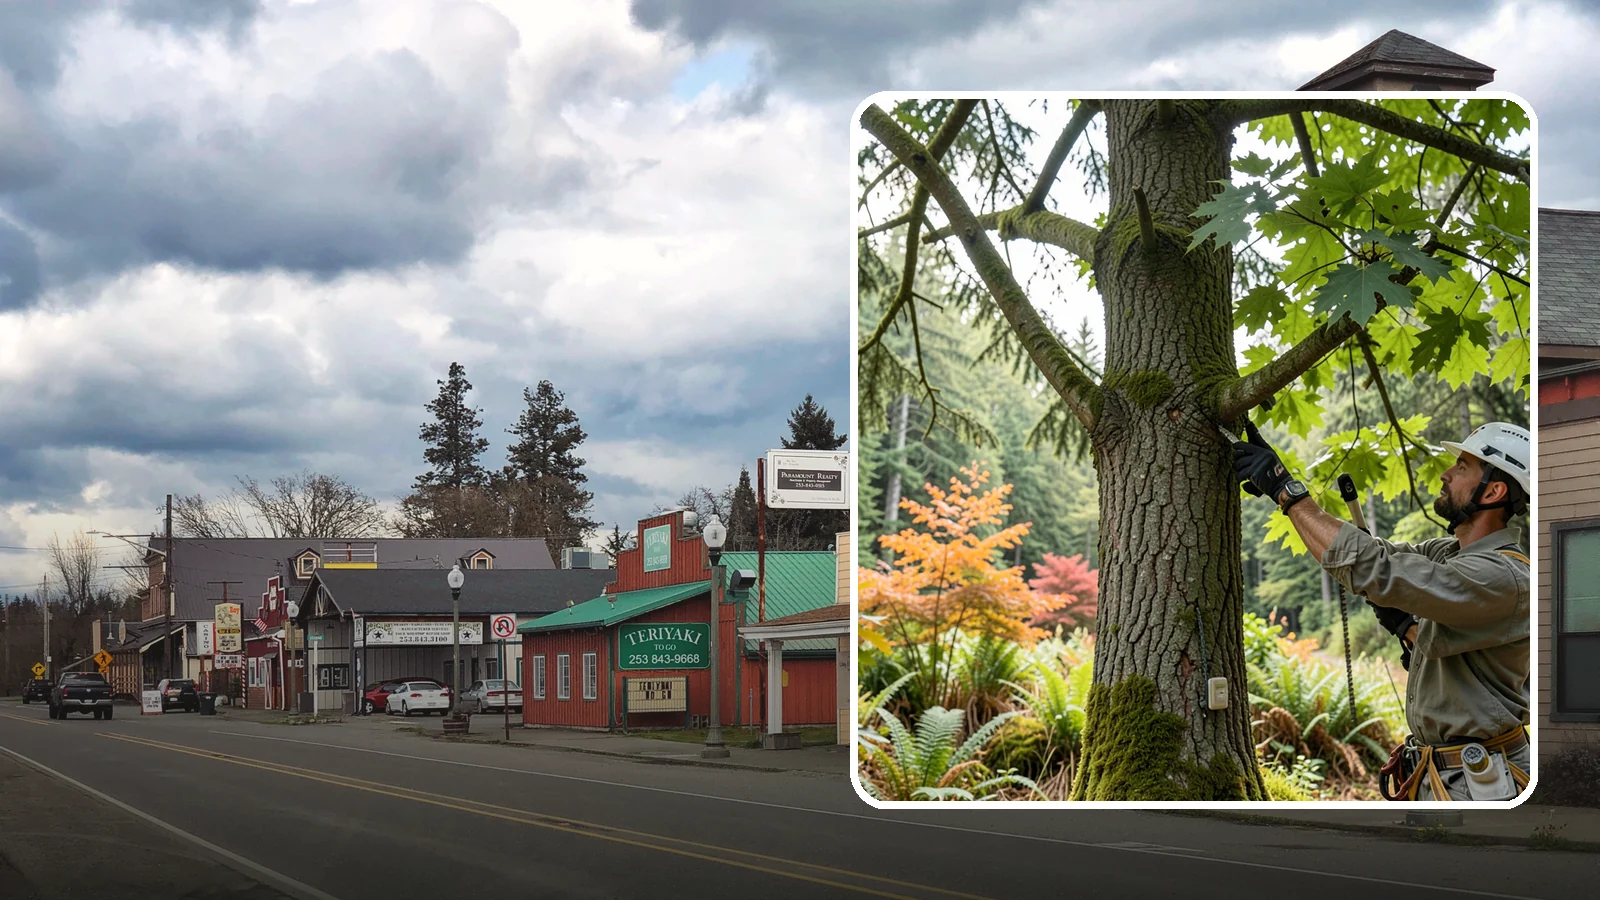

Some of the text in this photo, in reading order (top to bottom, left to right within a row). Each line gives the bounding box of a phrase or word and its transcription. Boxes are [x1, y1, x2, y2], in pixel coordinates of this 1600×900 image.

[781, 471, 839, 480] PARAMOUNT REALTY
[647, 531, 669, 548] TERIYAKI
[624, 627, 702, 646] TERIYAKI
[629, 653, 700, 664] 253 843-9668
[639, 681, 672, 691] TERIYAKI
